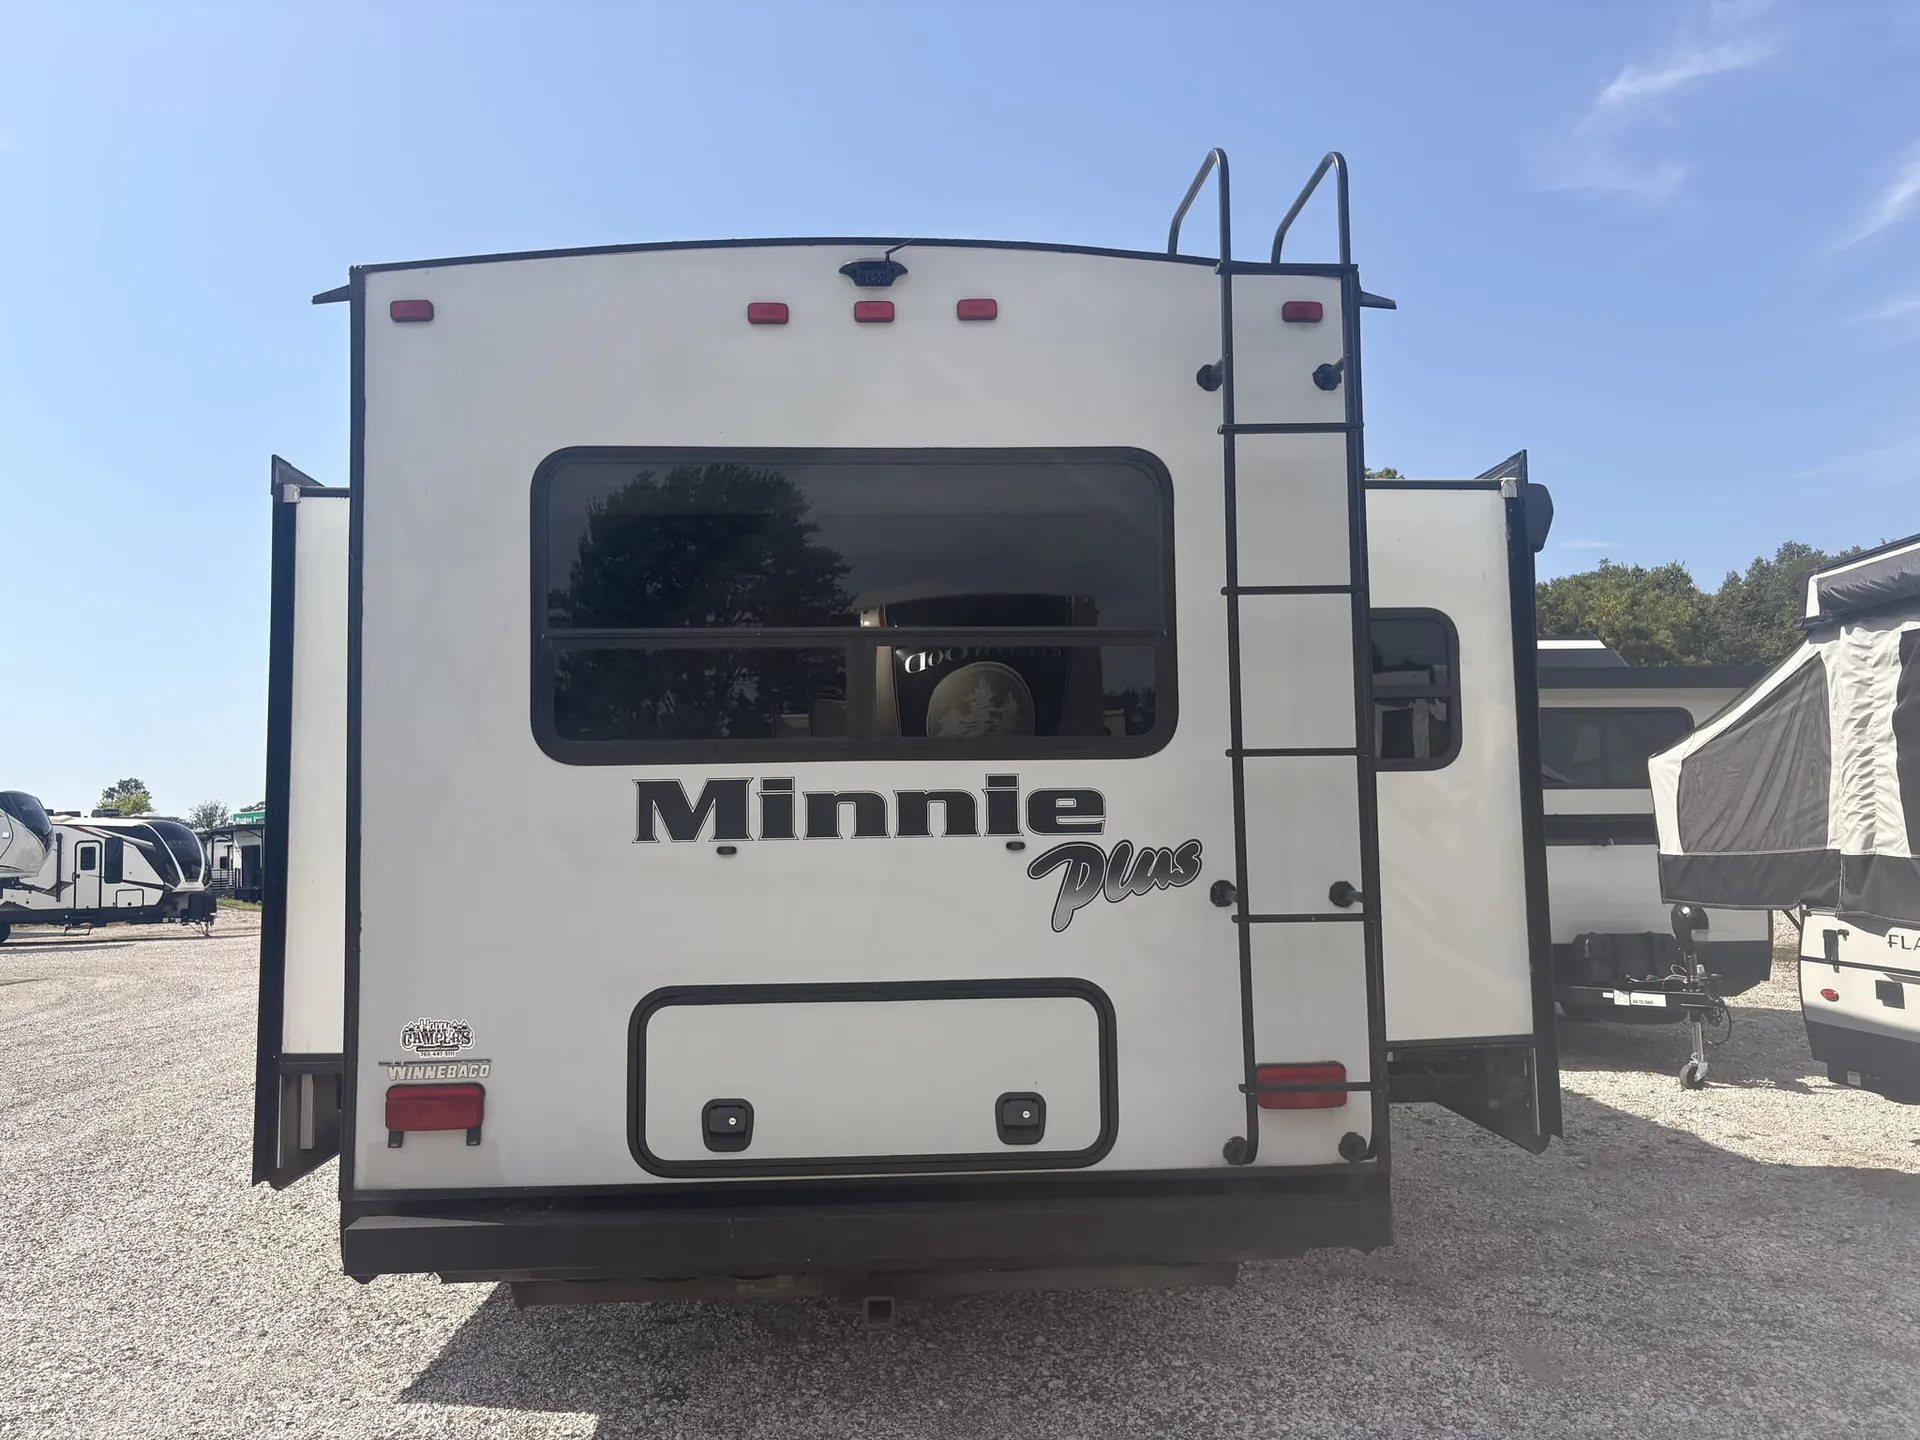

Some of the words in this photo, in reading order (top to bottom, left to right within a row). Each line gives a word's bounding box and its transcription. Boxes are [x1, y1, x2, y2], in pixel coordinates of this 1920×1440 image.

[632, 773, 1107, 844] Minnie
[1027, 839, 1203, 933] Plus
[417, 1018, 453, 1032] Happy
[403, 1030, 472, 1047] CAMPERS
[388, 1064, 491, 1080] WINNEBAGO
